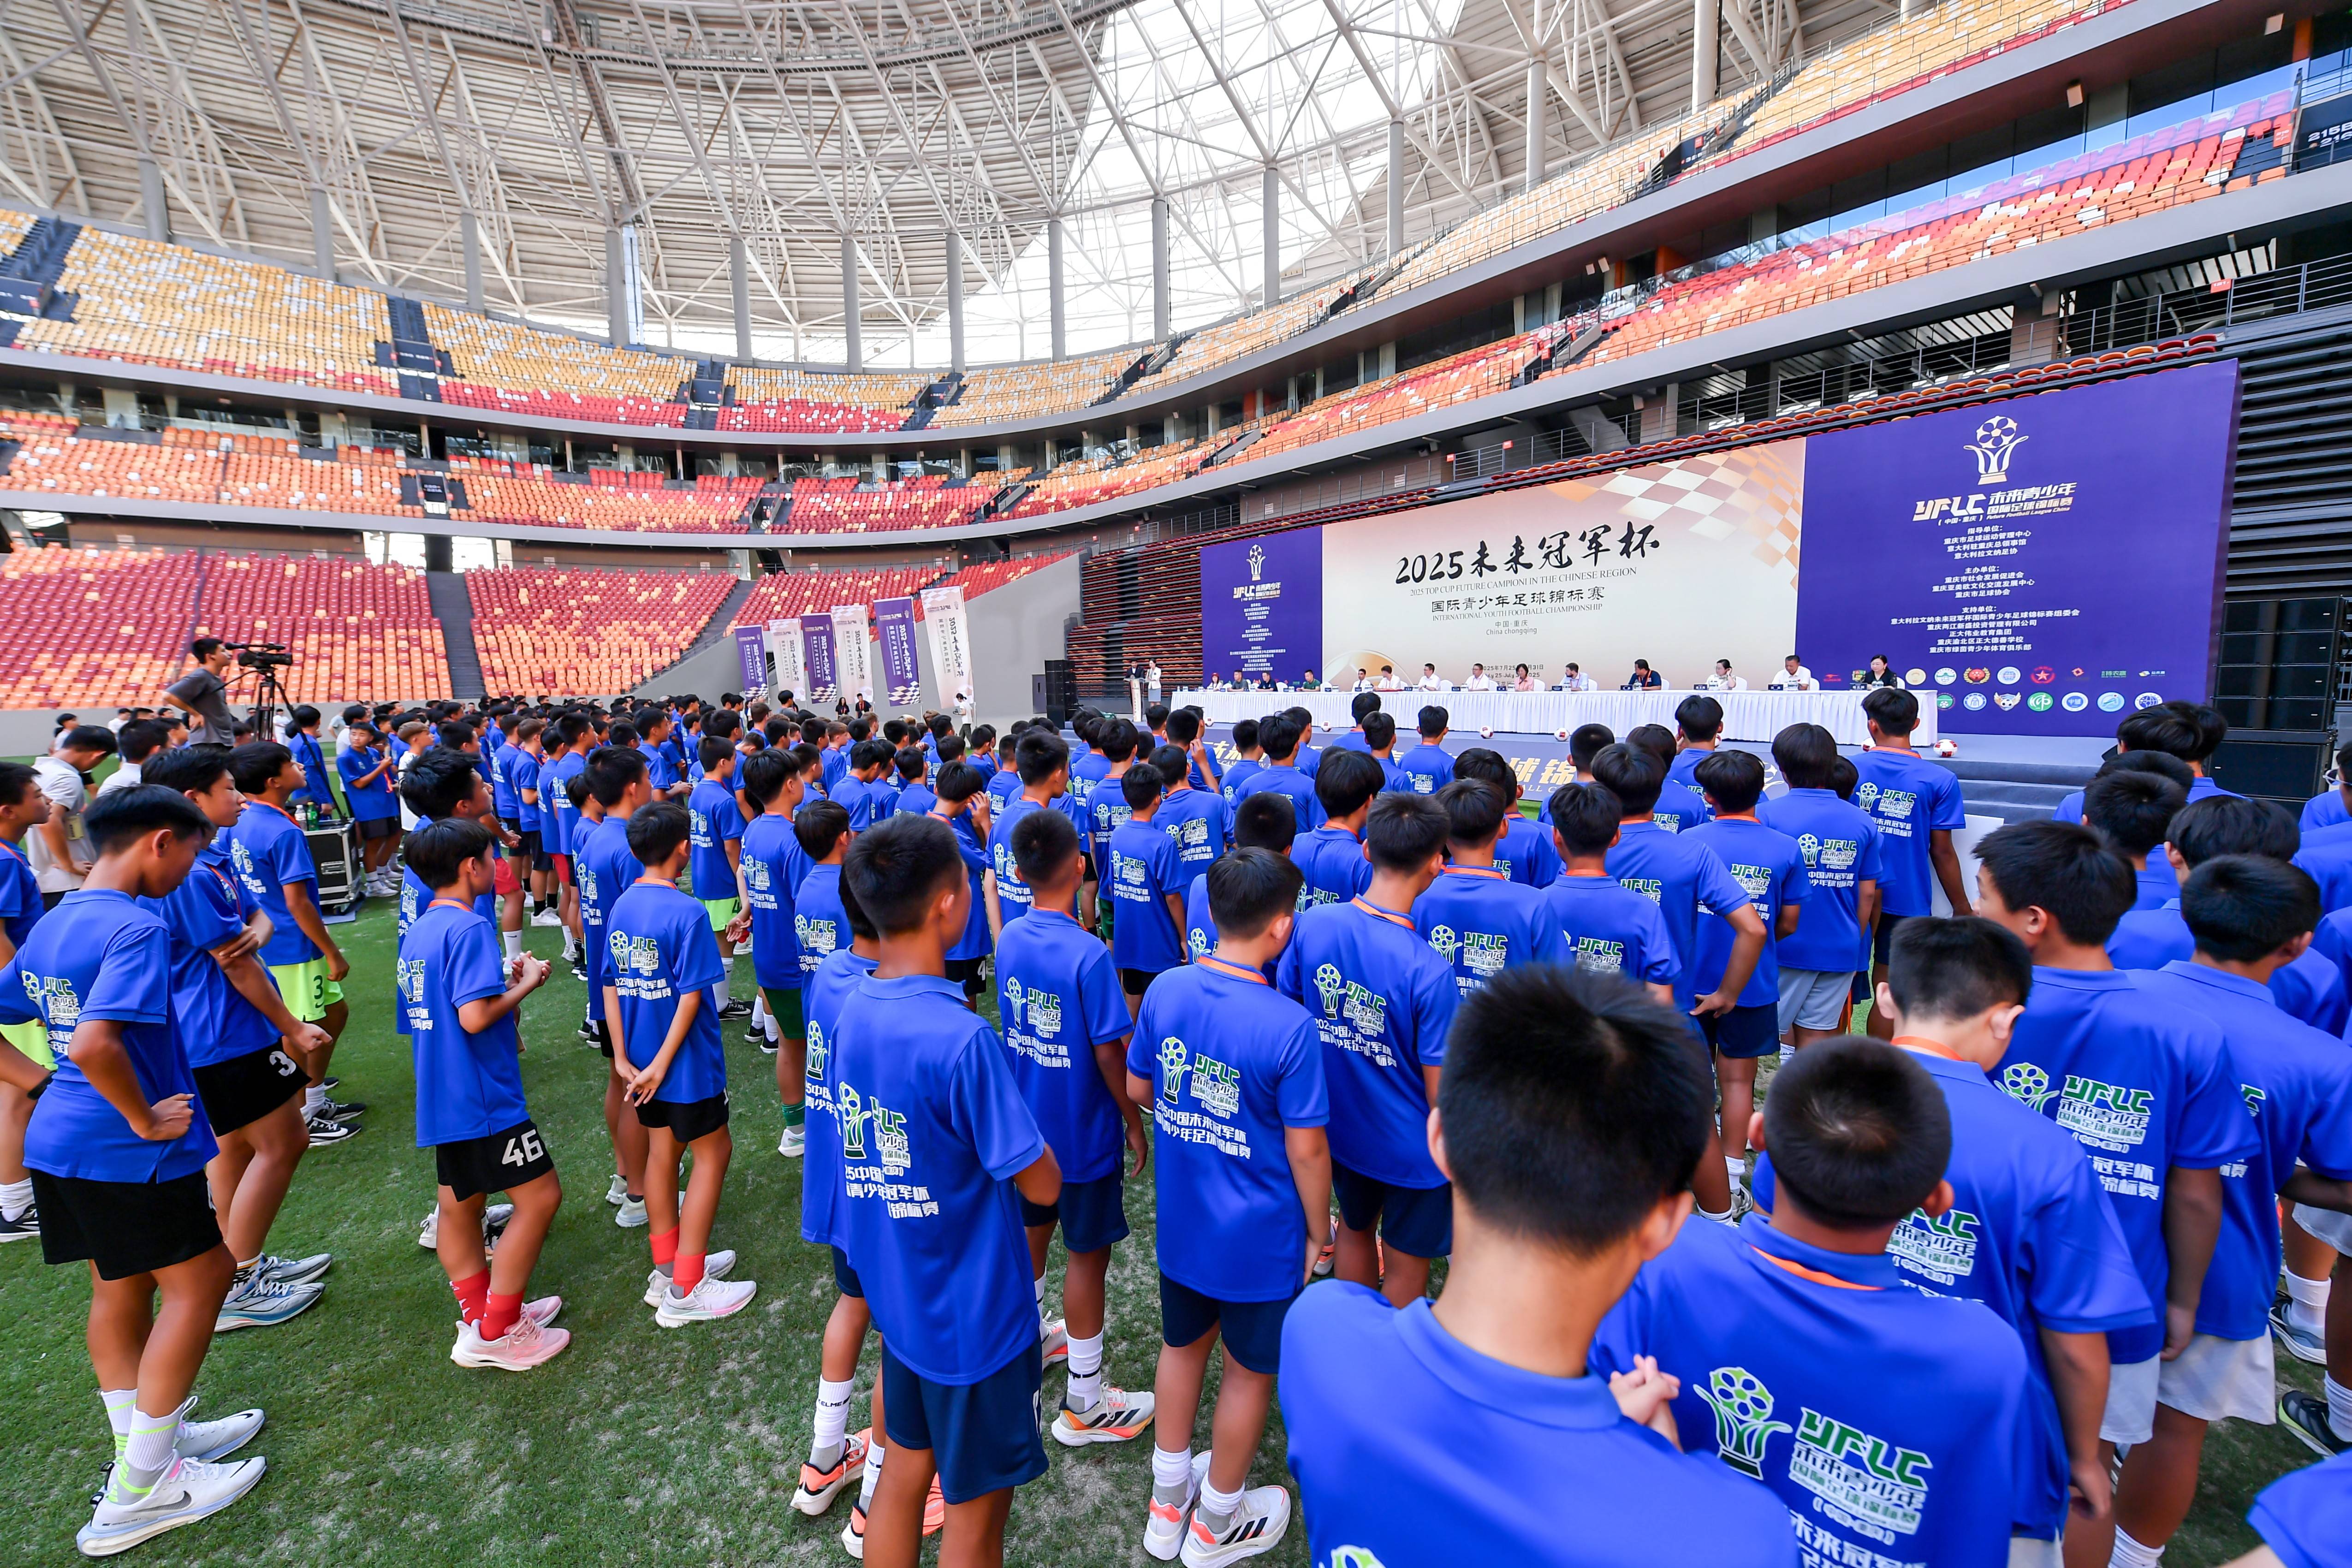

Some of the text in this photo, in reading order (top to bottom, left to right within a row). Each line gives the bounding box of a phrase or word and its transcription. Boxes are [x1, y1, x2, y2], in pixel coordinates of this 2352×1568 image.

[2308, 121, 2352, 142] 215B
[2320, 131, 2352, 147] 216
[1989, 482, 2077, 505] 未来青少年
[1912, 493, 1987, 522] YFLC
[1987, 497, 2073, 514] 国际足球锦标赛
[2030, 509, 2052, 517] League
[1943, 530, 2032, 545] 重庆市足球运动管理中心
[1947, 539, 2027, 552] 意大利驻重庆总领事馆
[1395, 521, 1660, 585] 2025未来冠军杯
[1954, 548, 2018, 560] 意大利拉文纳足协
[1425, 587, 1439, 595] TOP
[1440, 585, 1455, 594] CUP
[1456, 582, 1485, 592] FUTURE
[1487, 578, 1527, 589] CAMPIONI
[1528, 577, 1538, 586] IN
[1540, 575, 1557, 585] THE
[1559, 571, 1598, 582] CHINESE
[1599, 567, 1637, 578] REGION
[1944, 571, 2024, 583] 重庆市社会发展促进会
[1233, 585, 1255, 598] YFLC
[1932, 579, 2035, 592] 重庆亚美欧文化交流发展中心
[1431, 586, 1605, 613] 国际青少年足球锦标赛
[1955, 589, 2011, 599] 重庆市足球协会
[1432, 603, 1603, 622] INTERNATIONAL YOUTH FOOTBALL CHAMPIONSHIP
[1890, 609, 2080, 625] 意大利拉文纳未来冠军杯国际青少年足球锦标赛组委会
[1504, 627, 1537, 635] chongqing
[1949, 628, 2012, 637] 正大伟业教育集团
[1929, 644, 2032, 654] 重庆市绿茵青少年体育俱乐部
[1882, 789, 1917, 804] YFLC
[1111, 806, 1133, 815] YFLC
[1183, 818, 1207, 832] YFLC
[1653, 814, 1680, 825] YFLC
[1823, 839, 1858, 852] YFLC
[1123, 856, 1146, 870] YFLC
[1731, 863, 1772, 881] YFLC
[1464, 931, 1509, 952] YFLC
[1578, 937, 1624, 956] YFLC
[1346, 980, 1387, 1016] YFLC
[269, 1051, 297, 1077] 3
[1193, 1052, 1241, 1092] YFLC
[2061, 1075, 2155, 1115] YFLC
[2058, 1099, 2150, 1128] 未来青少年
[501, 1128, 545, 1168] 46
[1795, 1407, 1933, 1491] YFLC
[1791, 1441, 1927, 1510] 未来青少年
